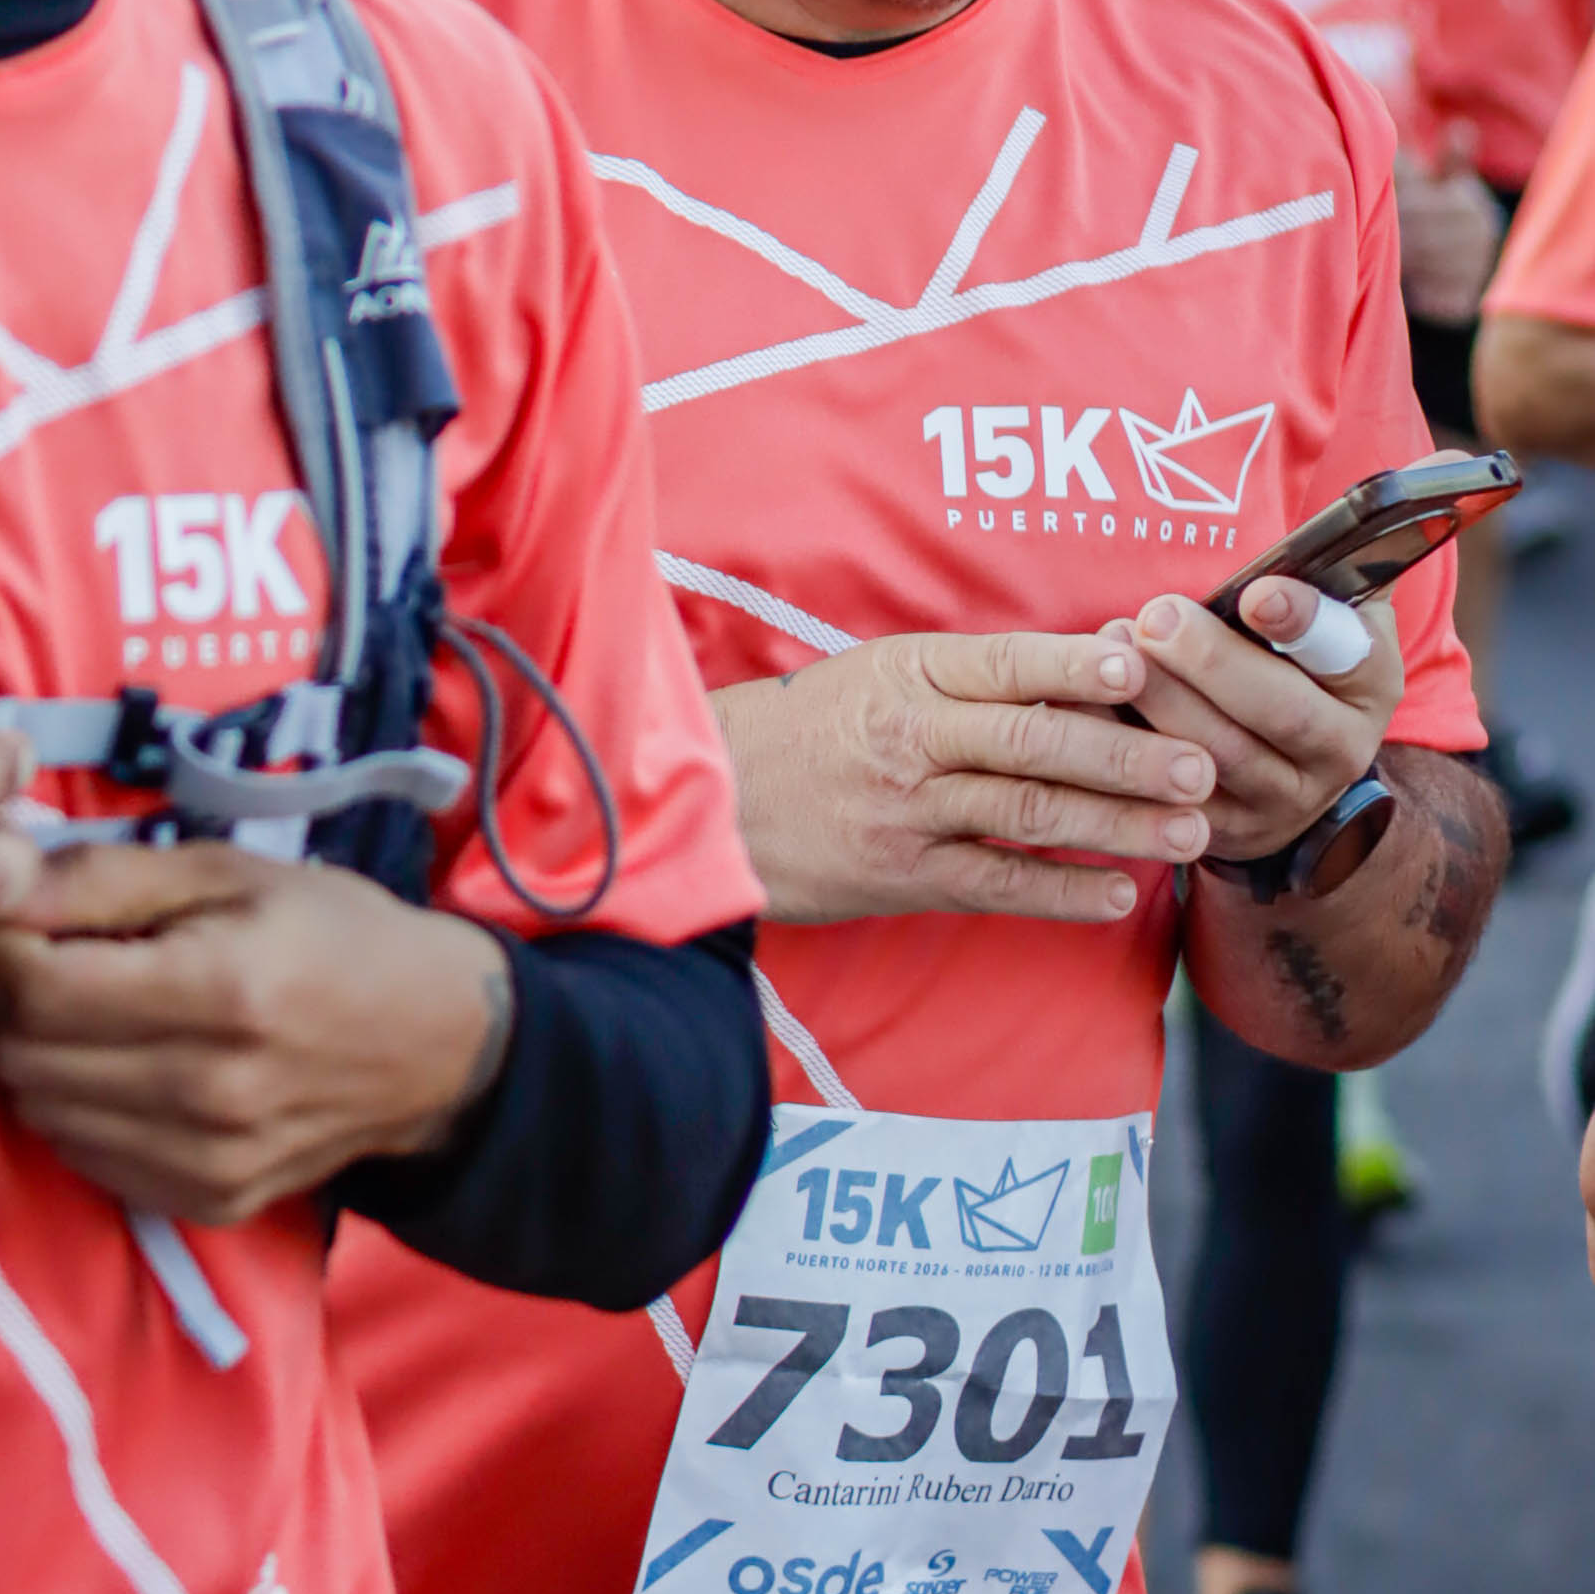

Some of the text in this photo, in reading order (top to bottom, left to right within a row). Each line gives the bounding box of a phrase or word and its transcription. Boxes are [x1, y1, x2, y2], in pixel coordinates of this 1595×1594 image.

[922, 404, 1117, 501] 15K
[94, 488, 311, 624] 15K
[946, 508, 1237, 549] PUERTO NORTE
[796, 1166, 943, 1250] 15K
[785, 1251, 850, 1270] PUERTO
[855, 1257, 907, 1276] NORTE
[913, 1262, 949, 1277] 2026
[964, 1263, 1025, 1279] ROSARIO
[1054, 1263, 1071, 1278] DE
[706, 1293, 1146, 1463] 7301
[768, 1470, 1075, 1506] Cantarini Ruben Dario
[984, 1568, 1059, 1585] POWER
